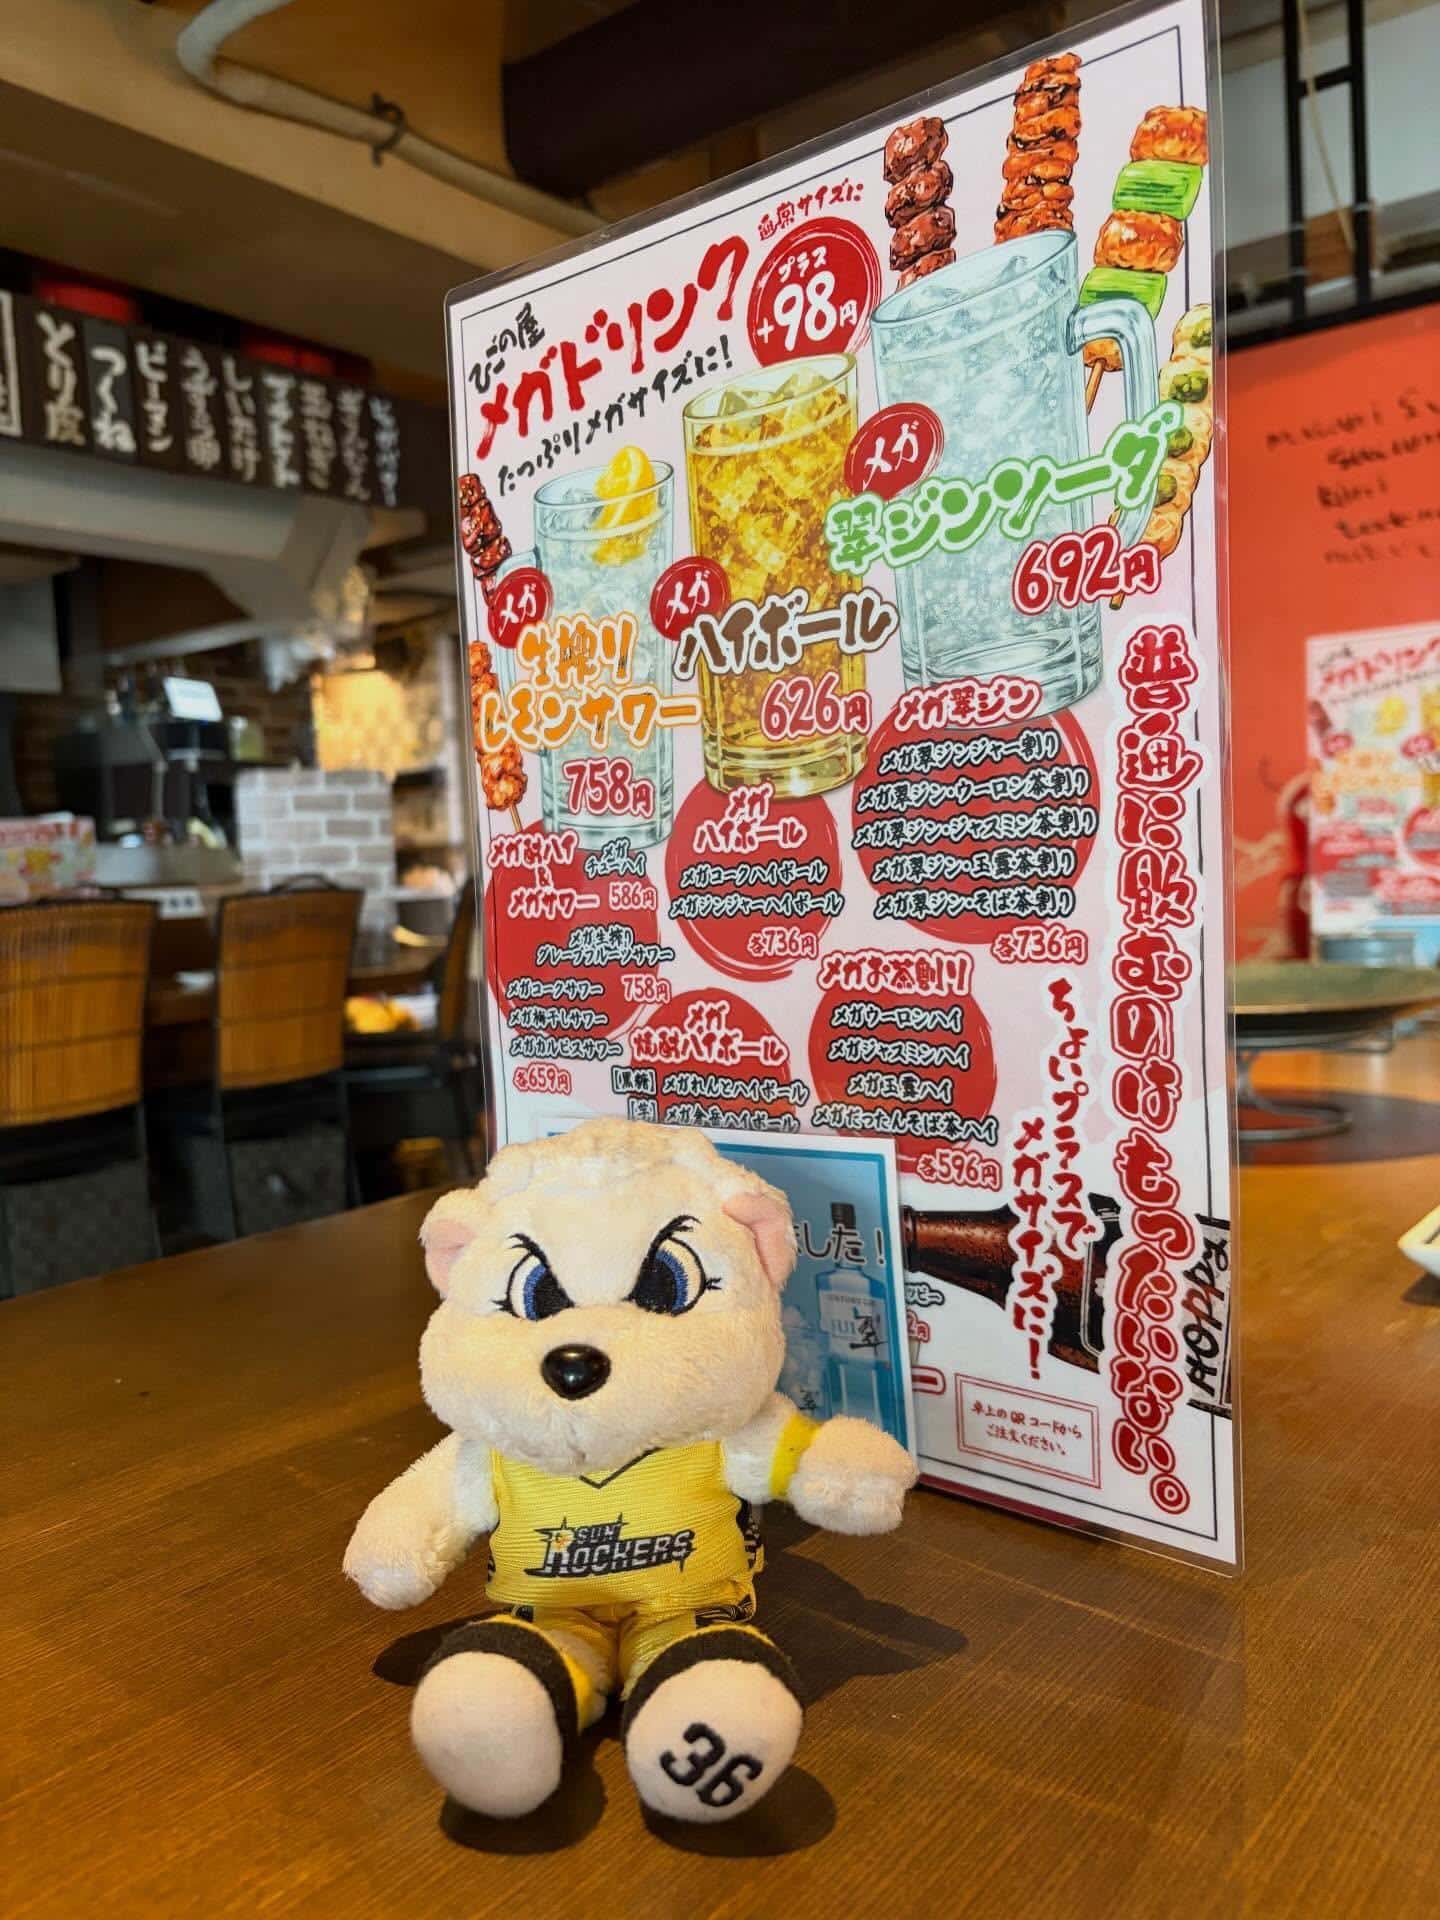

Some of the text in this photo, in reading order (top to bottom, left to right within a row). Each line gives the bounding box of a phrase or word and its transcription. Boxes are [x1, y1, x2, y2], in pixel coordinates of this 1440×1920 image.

[757, 178, 864, 240] 通常サイズに
[779, 245, 828, 284] プラス
[476, 235, 750, 460] メガドリンク
[91, 346, 138, 454] つくね
[861, 419, 921, 489] メガ
[825, 402, 1183, 575] 翠ジンソーダ
[1013, 526, 1161, 615] 692円
[500, 584, 537, 630] メガ
[666, 569, 713, 629] メガ
[518, 614, 637, 690] 生搾り
[673, 588, 899, 680] ハイボール
[481, 686, 701, 751] レモンサワー
[761, 672, 872, 741] 626円
[895, 676, 1042, 731] メガ翠ジン
[879, 729, 1061, 776] メガ翠ジンジャー割り
[563, 757, 657, 818] 758円
[726, 782, 775, 820] メガ
[488, 831, 577, 869] メガ酎ハイ
[601, 838, 631, 861] メガ
[693, 817, 807, 854] ハイボール
[584, 853, 647, 880] チューハイ
[680, 858, 829, 889] メガコークハイボール
[508, 887, 600, 920] メガサワー
[609, 881, 658, 912] 586円
[669, 889, 845, 920] メガジンジャーハイボール
[535, 944, 675, 968] グレープフルーツサワー
[747, 925, 819, 959] 各736円
[992, 924, 1088, 964] 各736円
[505, 978, 604, 1002] メガコークサワー
[621, 975, 672, 1005] 758円
[817, 949, 974, 996] メガお茶割り
[508, 1006, 610, 1031] メガ梅干しサワー
[685, 999, 729, 1032] メガ
[829, 1001, 964, 1034] メガウーロンハイ
[510, 1035, 624, 1061] メガカルピスサワー
[630, 1027, 790, 1066] 焼酎ハイボール
[827, 1036, 972, 1071] メガジャスミンハイ
[513, 1063, 571, 1096] 各659円
[846, 1071, 954, 1105] メガ玉露ハイ
[1047, 977, 1098, 1253] ちょいプラスで
[916, 1150, 1002, 1191] 各596円
[971, 1400, 1082, 1440] 卓上の QR コードから
[542, 1530, 694, 1576] ROCKERS
[576, 1525, 616, 1545] SUN
[660, 1722, 763, 1807] 36
